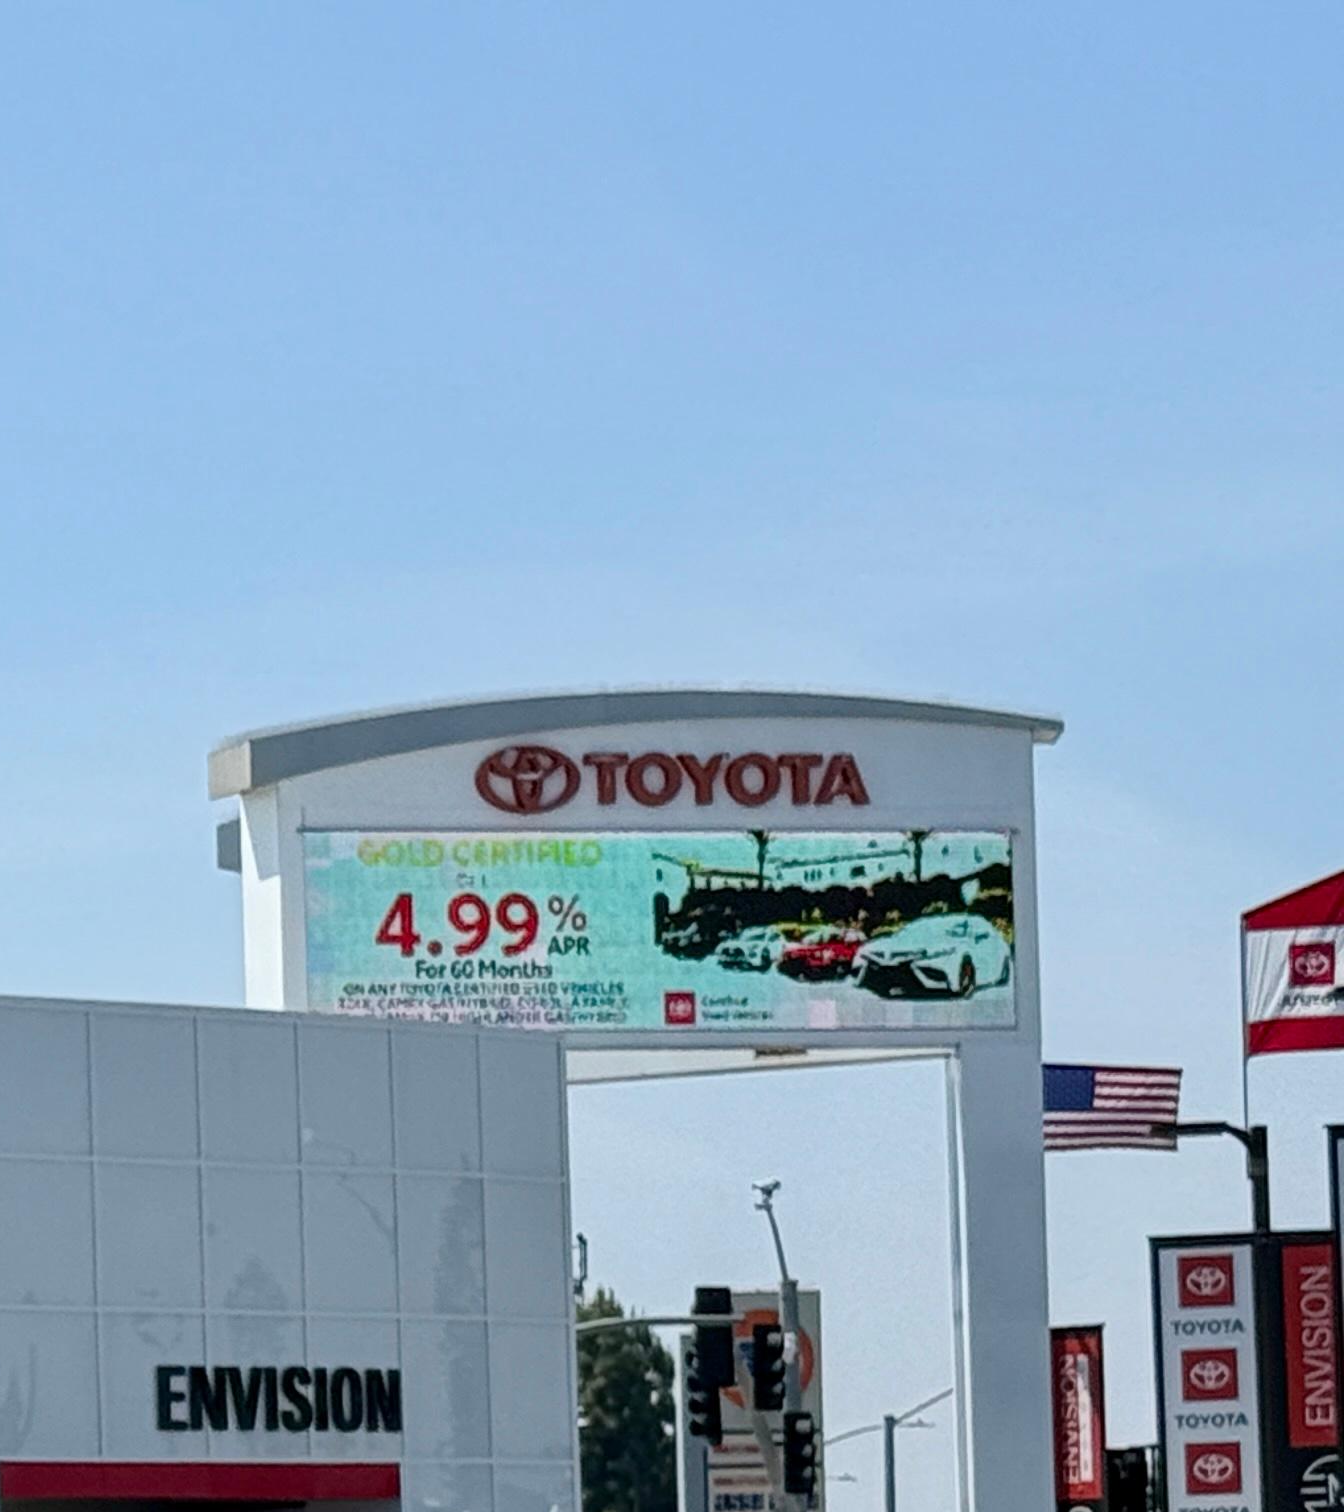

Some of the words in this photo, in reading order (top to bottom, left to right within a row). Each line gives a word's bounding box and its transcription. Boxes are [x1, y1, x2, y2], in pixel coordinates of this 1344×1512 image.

[582, 751, 871, 807] TOYOTA
[356, 839, 444, 868] GOLD
[450, 838, 602, 867] CERTIFIED
[546, 935, 591, 956] APR
[415, 959, 447, 979] For
[450, 960, 475, 980] 60
[477, 958, 554, 979] Months
[1170, 1318, 1245, 1336] TOYOTA
[1299, 1264, 1335, 1428] ENVISION
[155, 1364, 403, 1433] ENVISION
[1059, 1353, 1080, 1484] ENVISION
[1174, 1411, 1249, 1429] TOYOTA
